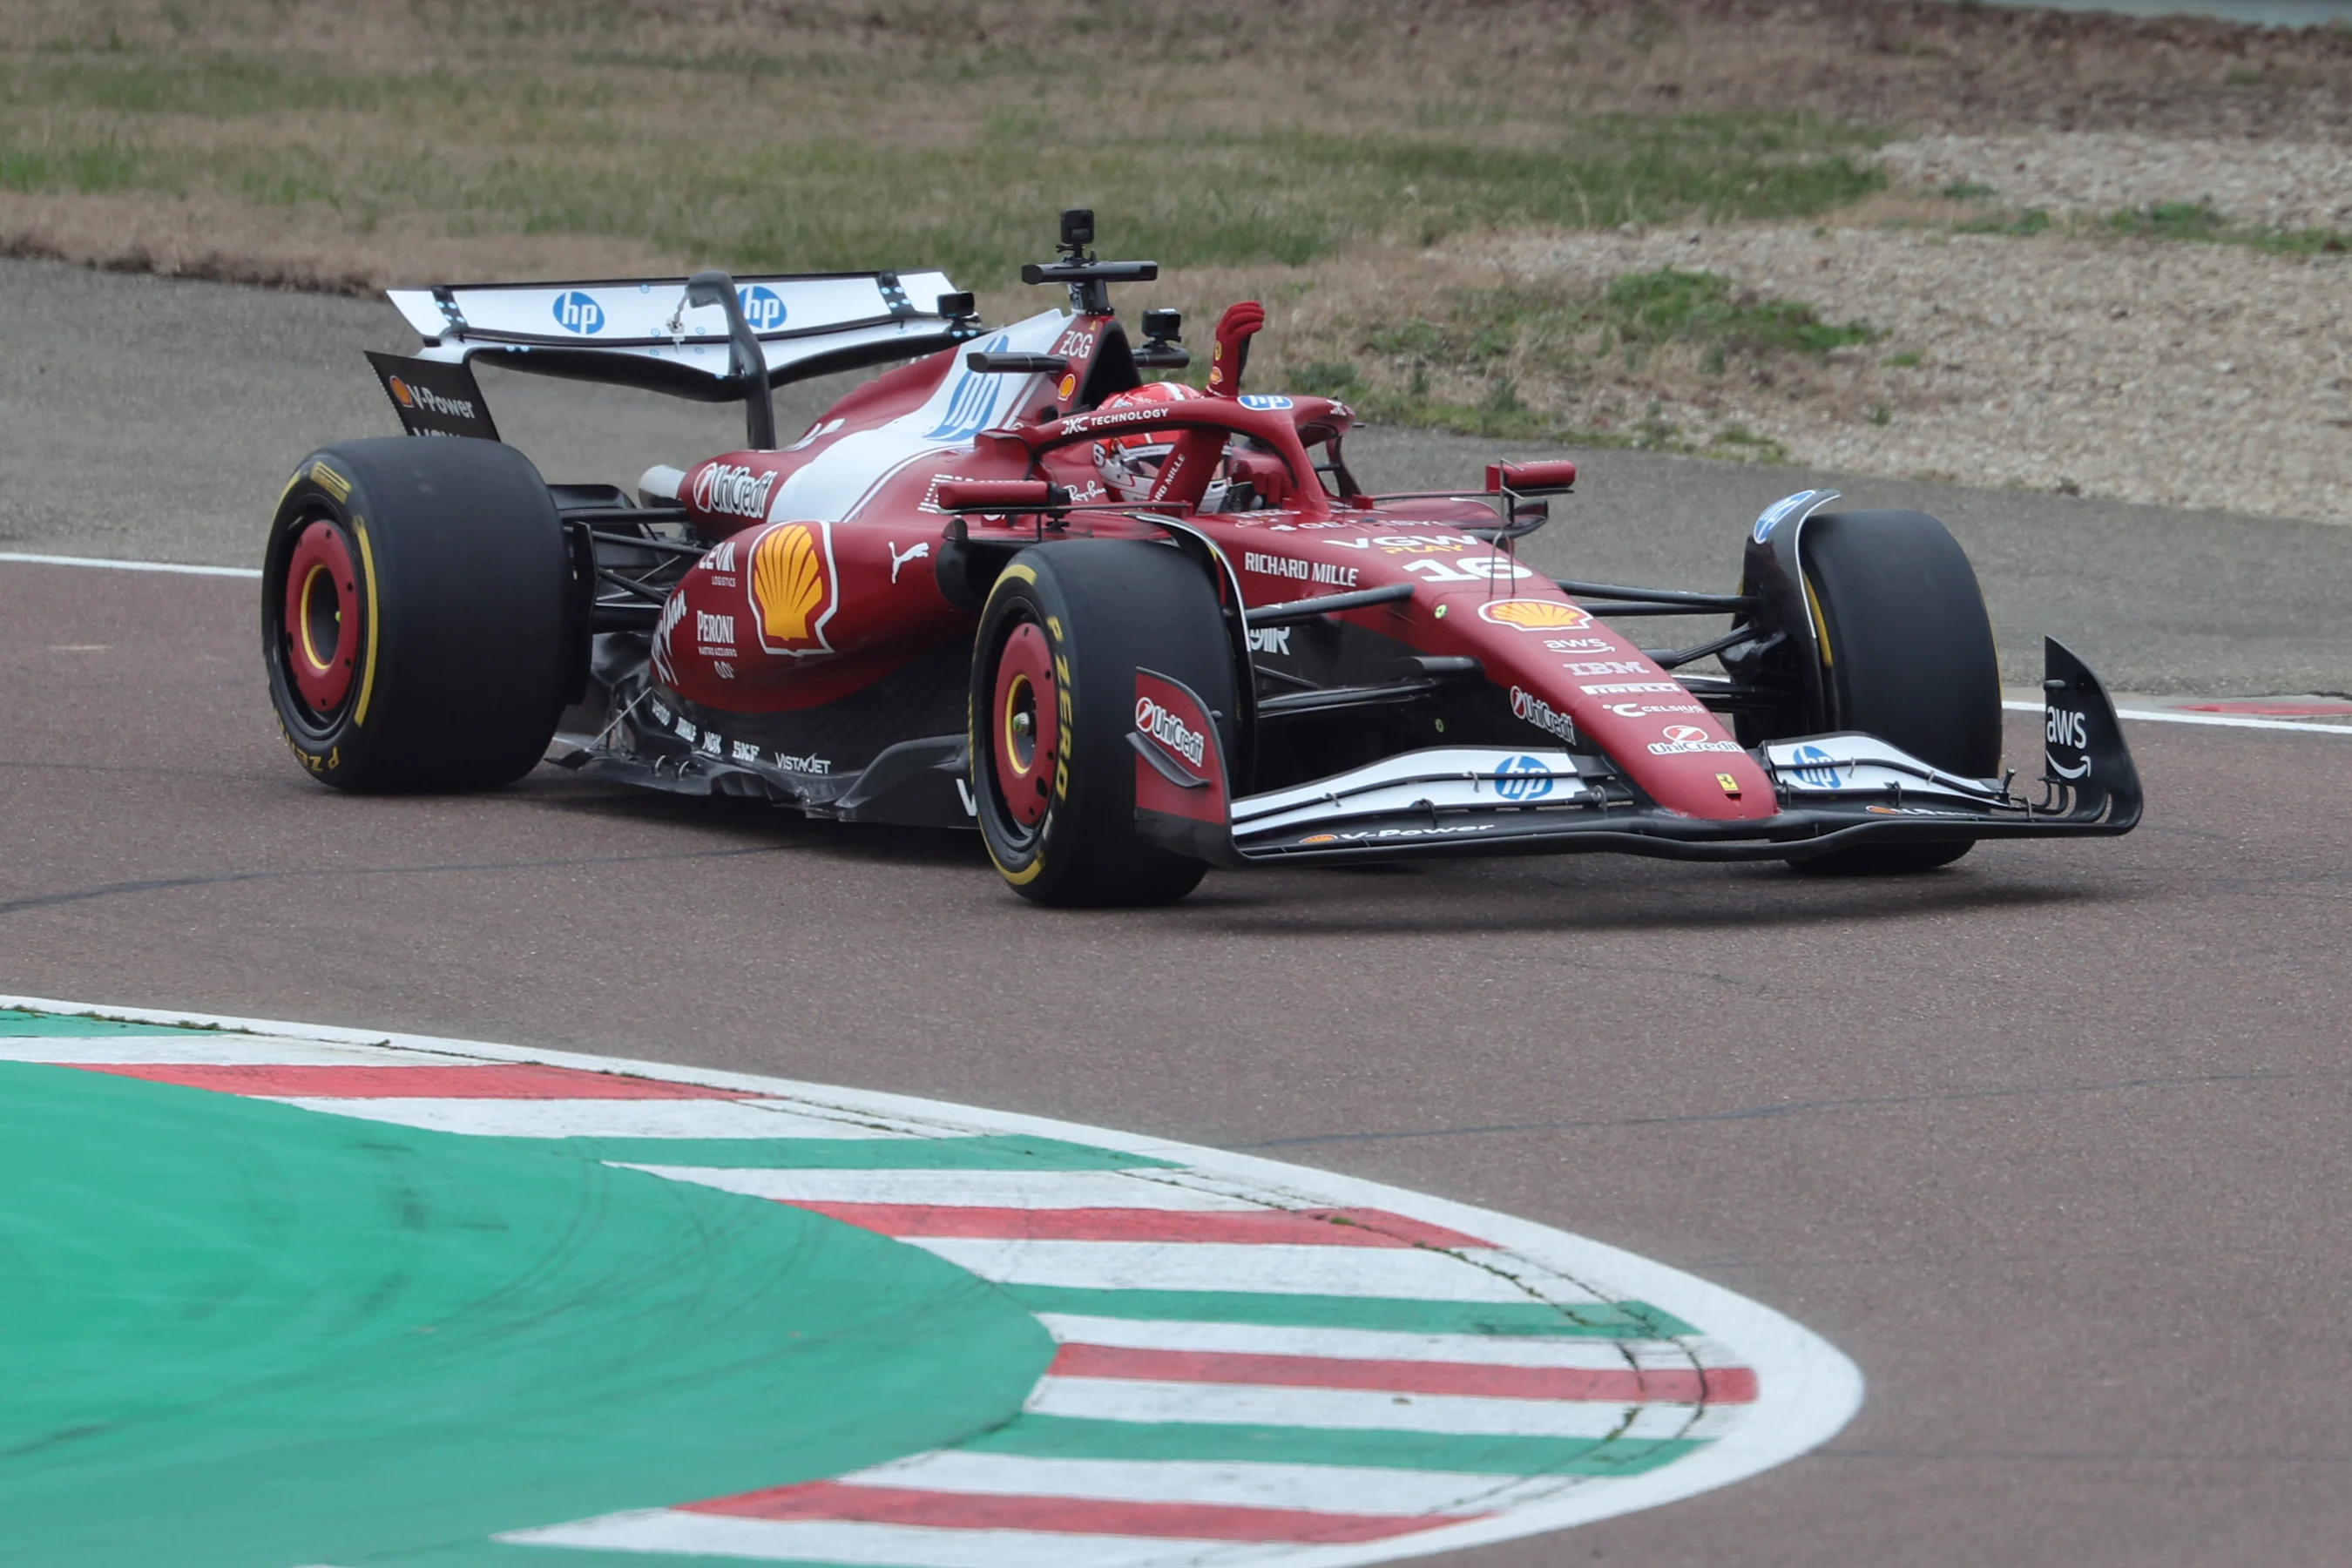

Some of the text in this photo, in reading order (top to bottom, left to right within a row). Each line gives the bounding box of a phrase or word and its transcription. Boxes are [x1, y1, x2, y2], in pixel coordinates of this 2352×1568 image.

[562, 291, 598, 335] hp
[744, 287, 781, 330] hp
[1058, 330, 1093, 359] ZCG
[406, 384, 475, 419] V-Power
[1091, 408, 1169, 426] TECHNOLOGY
[1166, 454, 1186, 485] MILLE
[711, 463, 779, 518] UniCredit
[1321, 535, 1479, 549] VGW
[1380, 544, 1463, 554] PLAY
[712, 576, 736, 588] LOGISTICS
[1244, 551, 1359, 587] RICHARD MILLE
[1402, 557, 1533, 582] 16
[697, 610, 735, 645] PERONI
[1543, 639, 1608, 649] aws
[1563, 661, 1650, 676] IBM
[1046, 615, 1073, 801] P ZERO
[1522, 693, 1577, 747] UniCredit
[1152, 706, 1204, 767] UniCredit
[2047, 706, 2087, 749] aws
[732, 740, 760, 762] SKF
[1647, 740, 1747, 755] UniCredit
[1501, 755, 1549, 801] hp
[1799, 746, 1835, 788] hp
[1340, 824, 1496, 839] V-Power
